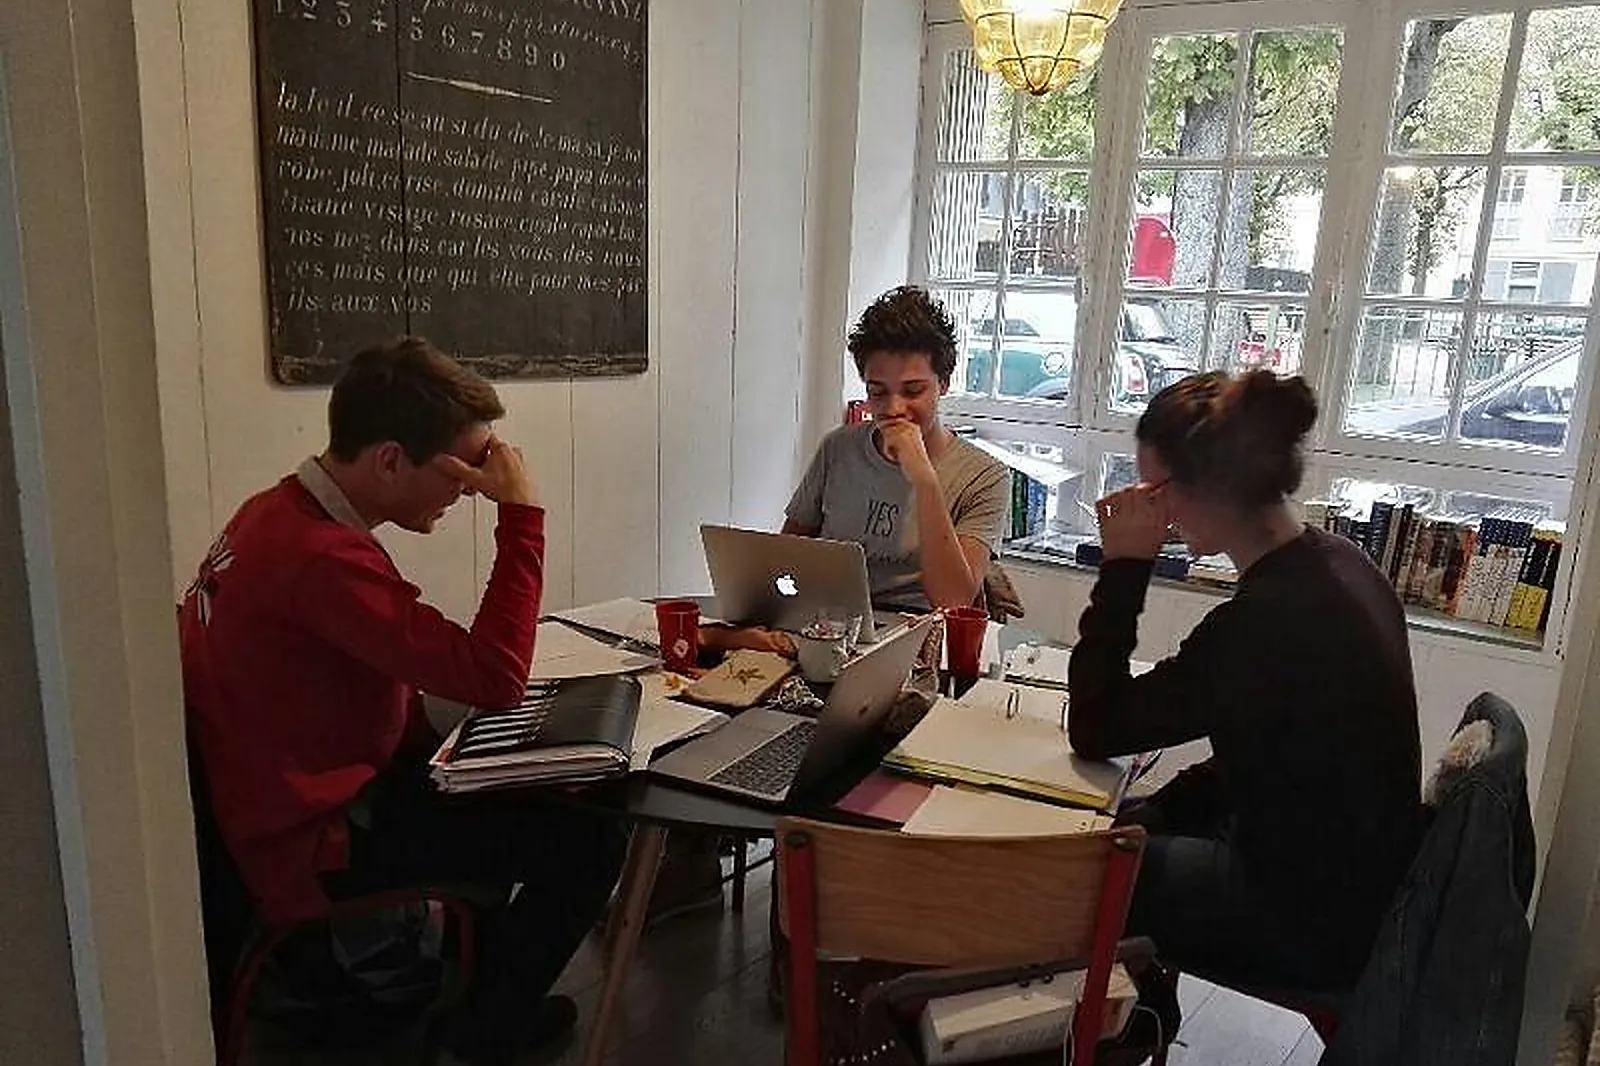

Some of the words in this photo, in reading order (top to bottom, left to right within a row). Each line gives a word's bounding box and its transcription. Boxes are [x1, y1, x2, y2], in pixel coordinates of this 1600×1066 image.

[410, 15, 423, 41] 5
[441, 24, 456, 48] 6
[471, 30, 485, 54] 7
[498, 38, 513, 61] 8
[524, 43, 538, 66] 9
[551, 50, 566, 71] 0
[863, 498, 900, 538] YES
